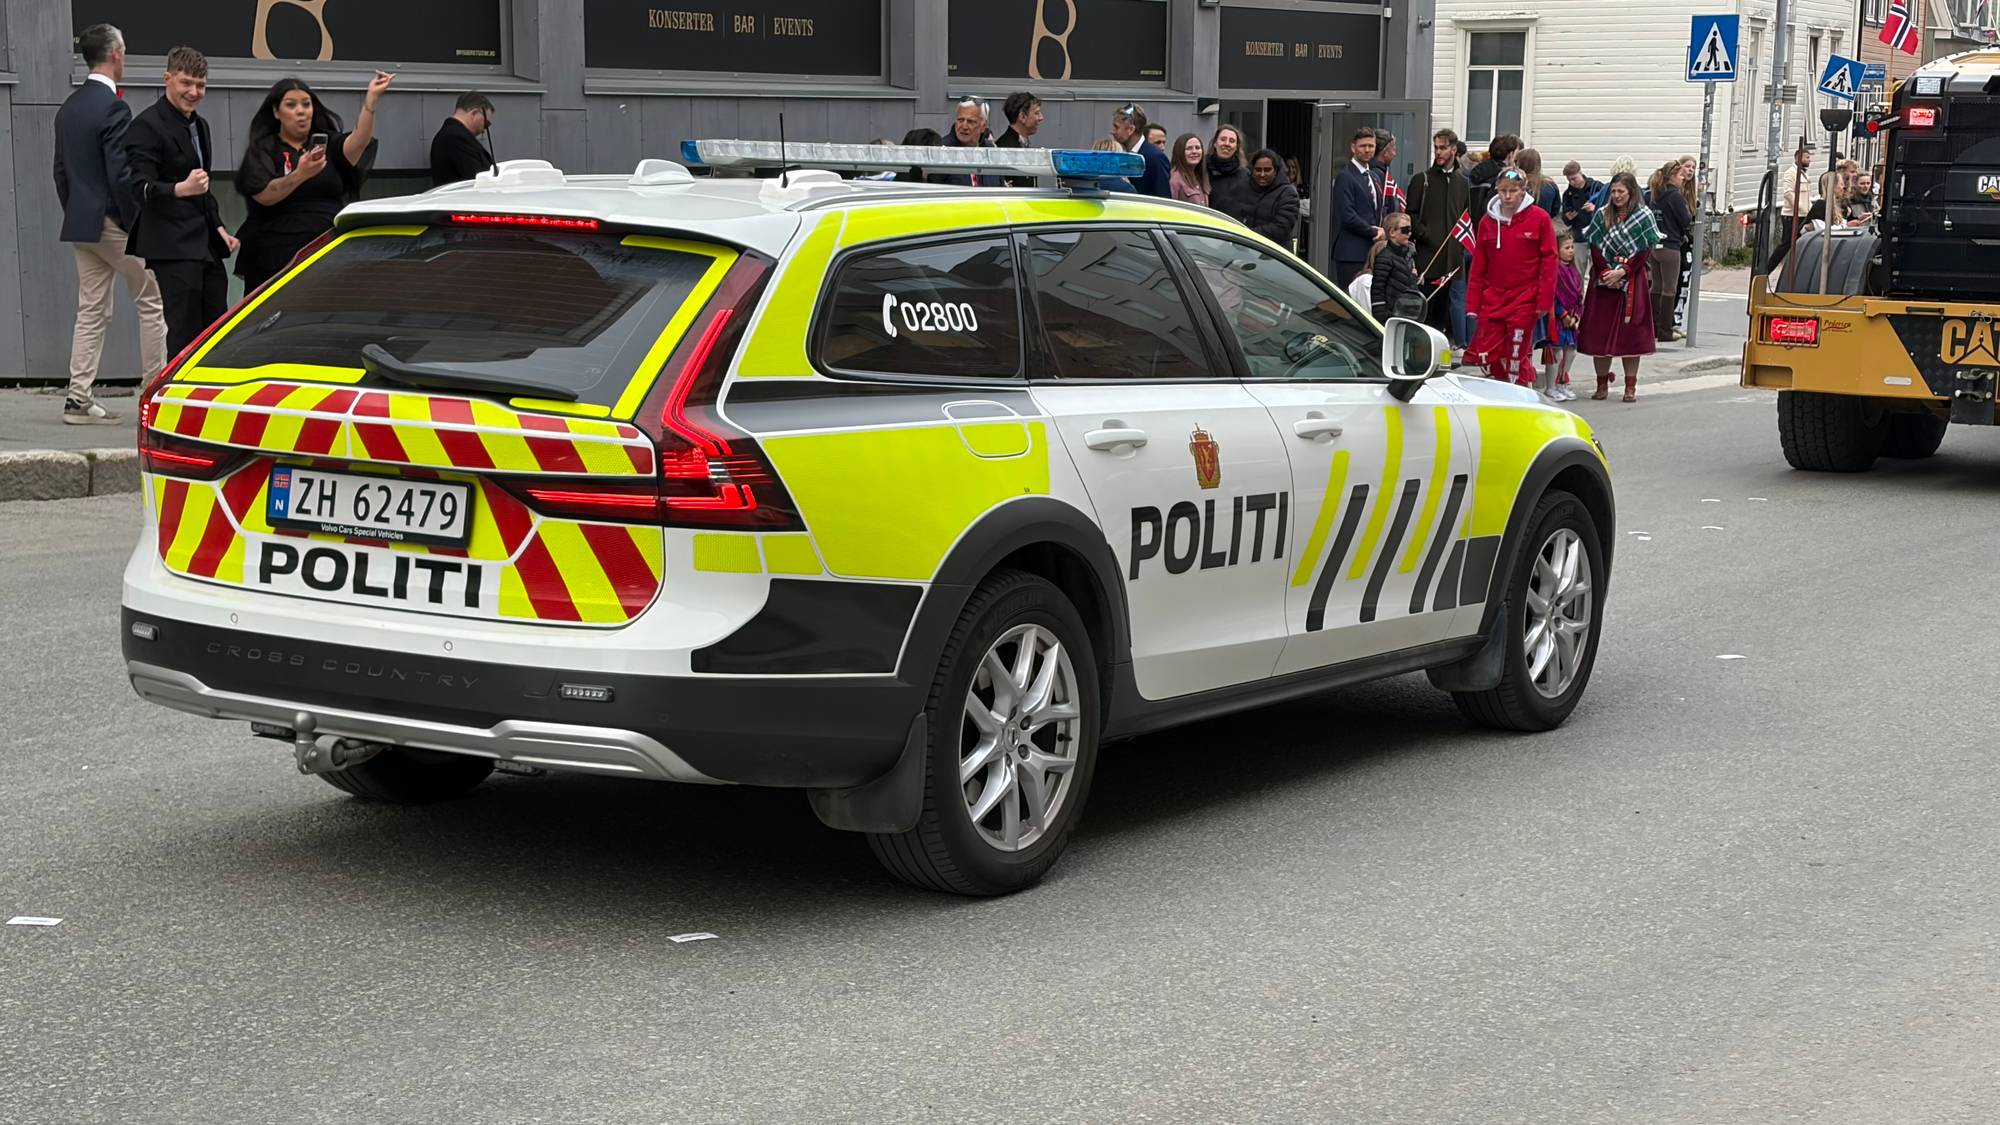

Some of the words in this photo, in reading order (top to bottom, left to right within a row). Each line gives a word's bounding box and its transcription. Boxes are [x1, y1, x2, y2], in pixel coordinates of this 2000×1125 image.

[648, 9, 715, 32] KONSERTER
[734, 15, 755, 34] BAR
[773, 17, 814, 36] EVENTS
[1245, 41, 1284, 56] KONSERTER
[1295, 43, 1308, 58] BAR
[1318, 44, 1343, 58] EVENTS
[1977, 175, 2000, 193] CA
[900, 302, 978, 332] 02800
[275, 499, 284, 511] N
[295, 477, 338, 518] ZH
[353, 483, 458, 530] 62479
[321, 523, 338, 534] Volvo
[338, 525, 353, 536] Cars
[353, 527, 377, 539] Special
[377, 529, 404, 541] Vehicles
[1129, 491, 1289, 581] POLITI
[259, 541, 483, 608] POLITI
[207, 642, 305, 666] CROSS
[322, 660, 480, 688] COUNTRY
